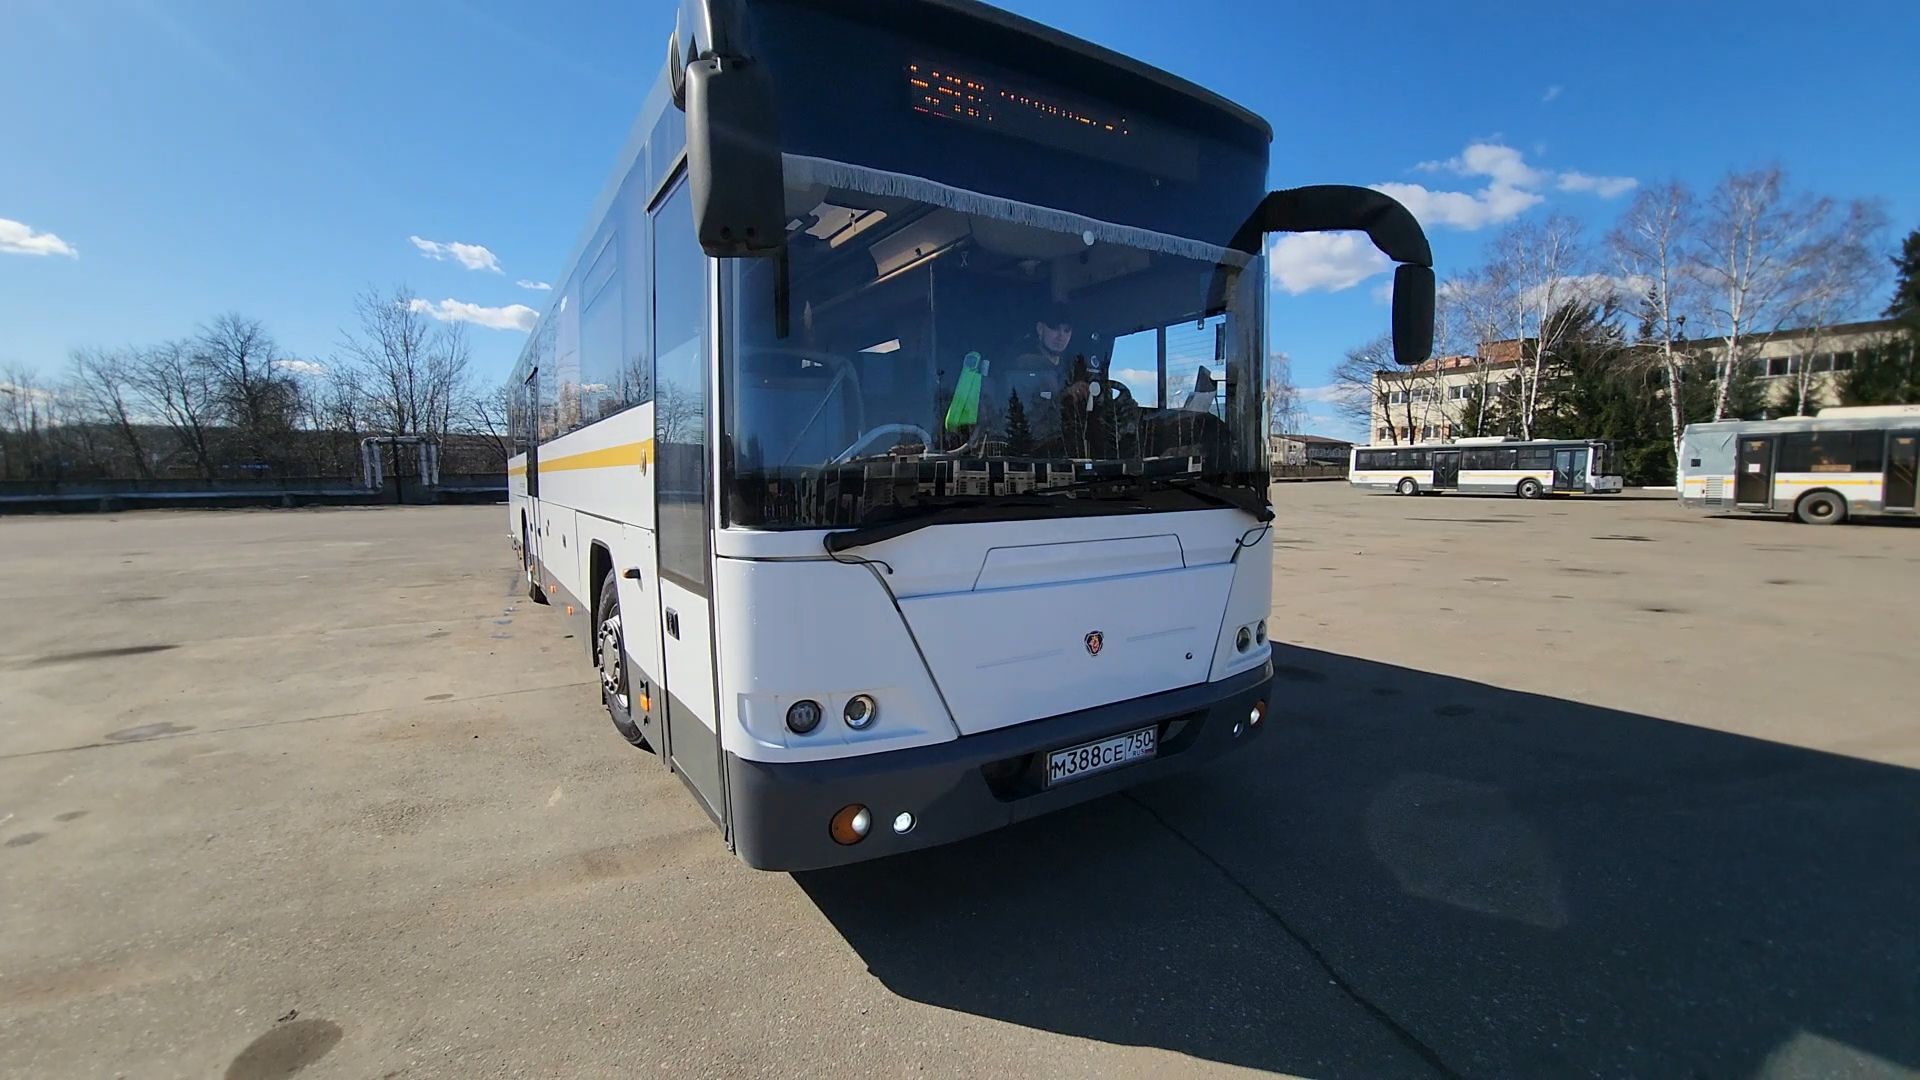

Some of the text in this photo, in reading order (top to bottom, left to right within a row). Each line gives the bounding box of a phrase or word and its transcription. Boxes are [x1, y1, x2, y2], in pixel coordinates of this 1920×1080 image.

[1053, 731, 1151, 779] М388СЕ 750
[1133, 749, 1145, 757] RUS
